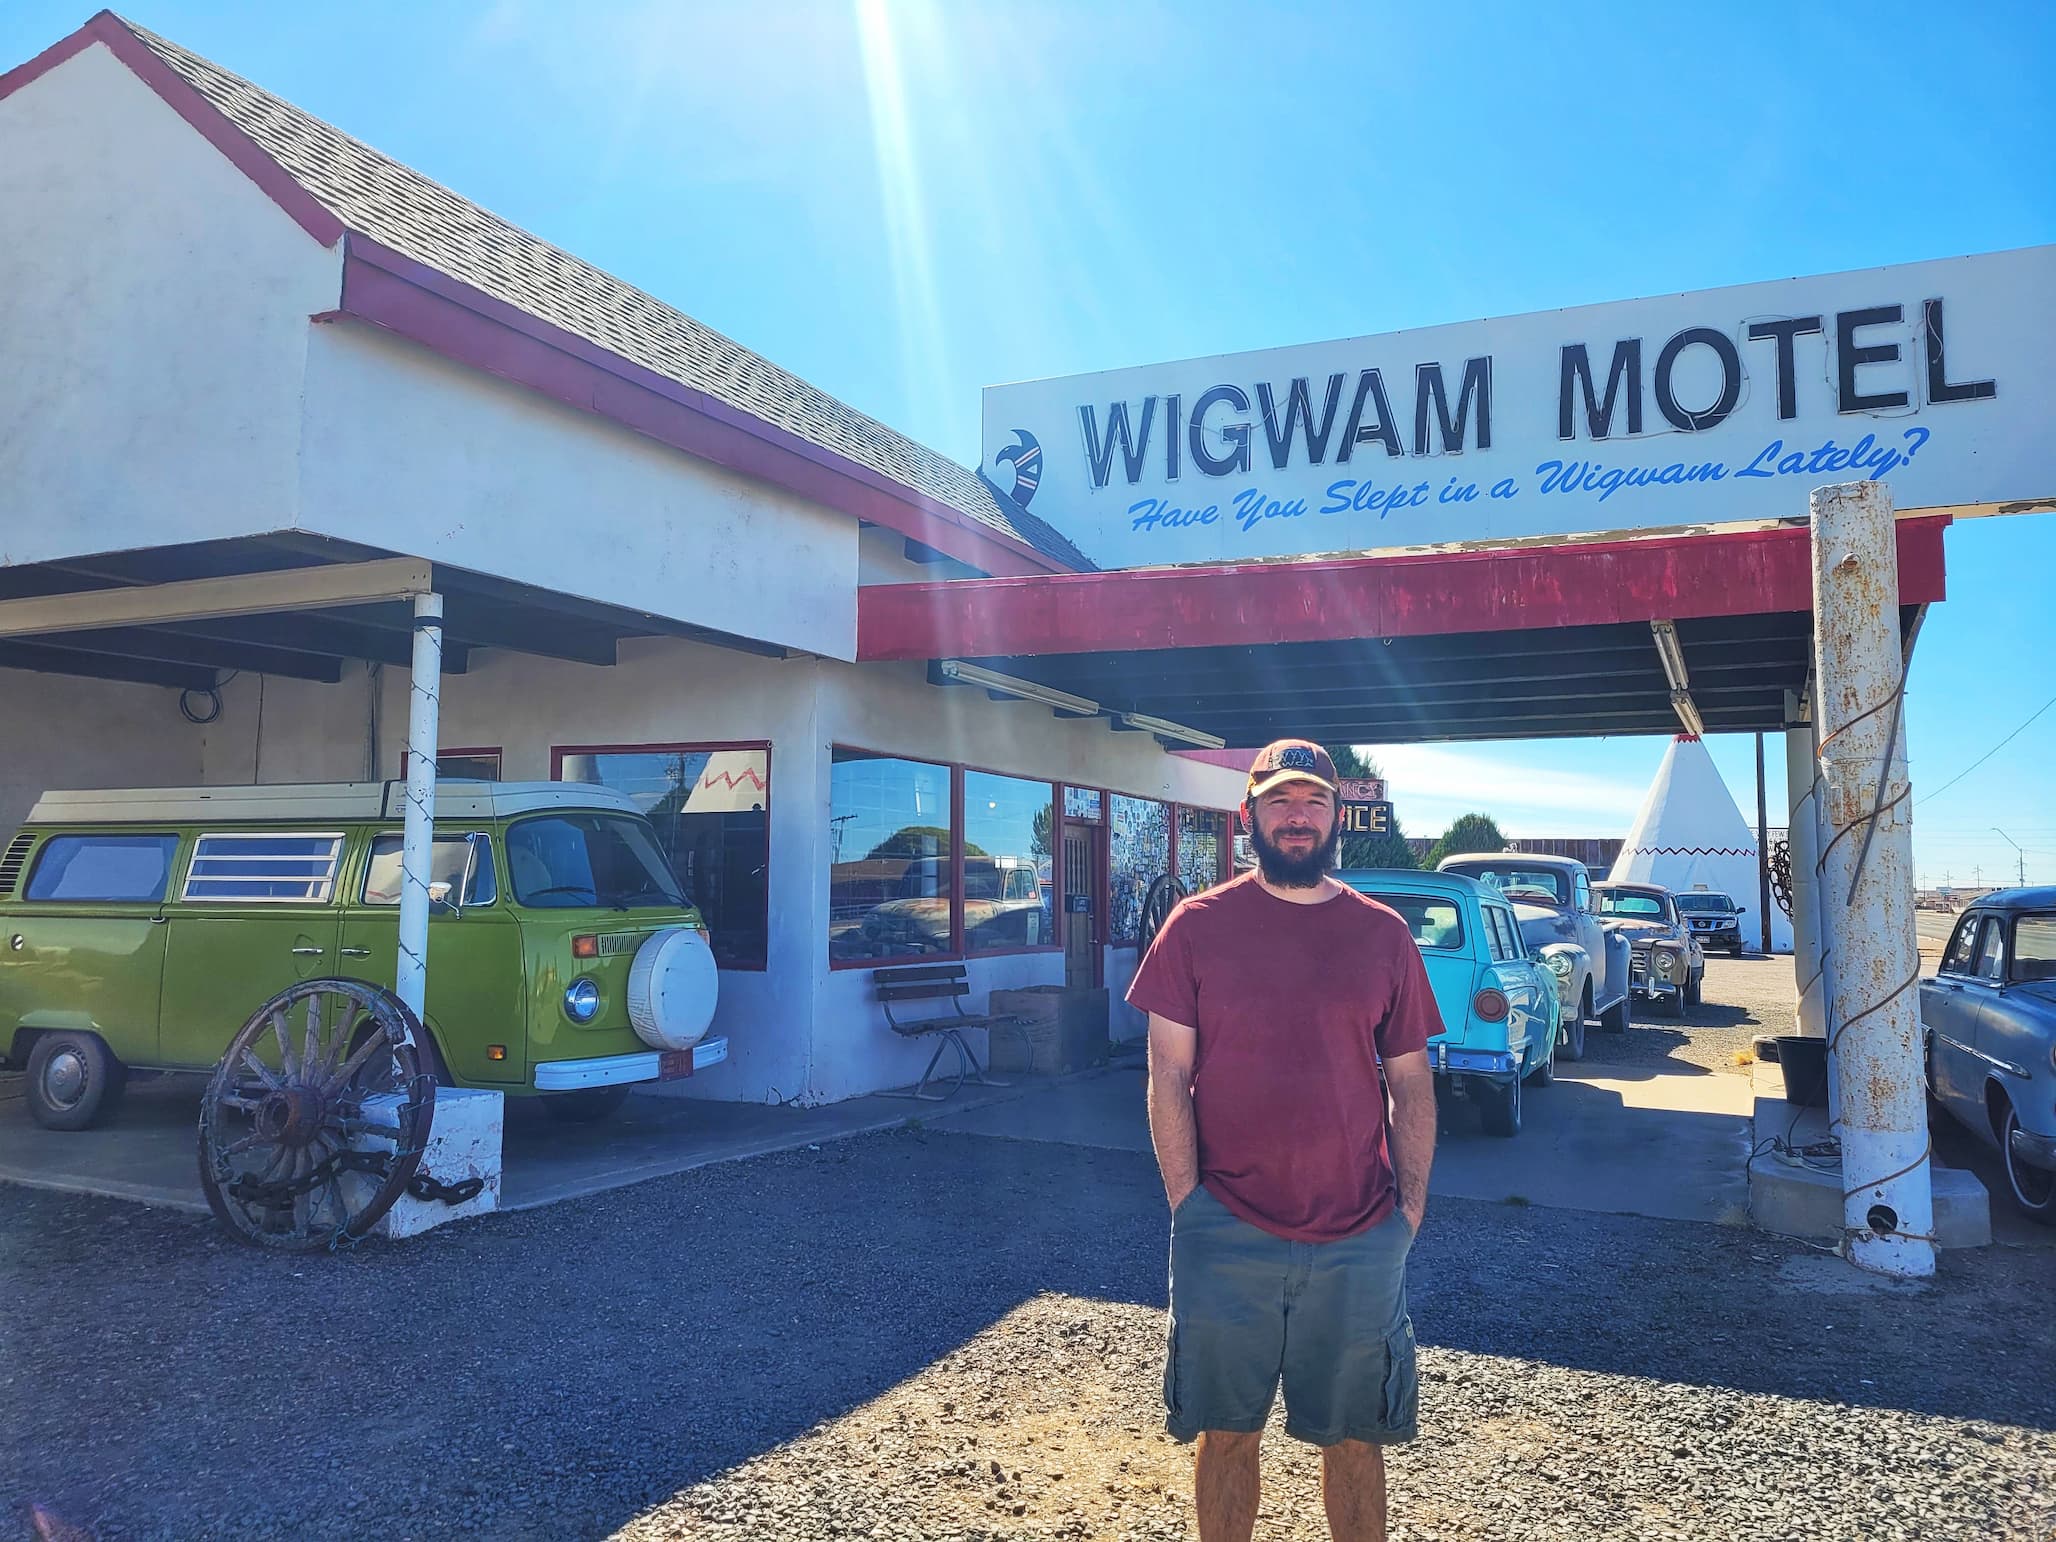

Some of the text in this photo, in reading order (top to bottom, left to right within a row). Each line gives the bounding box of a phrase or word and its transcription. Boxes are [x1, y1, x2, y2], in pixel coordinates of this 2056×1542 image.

[1079, 297, 1998, 489] WIGWAM MOTEL
[1128, 427, 1930, 532] Have You Slept in a Wigwam Lately?
